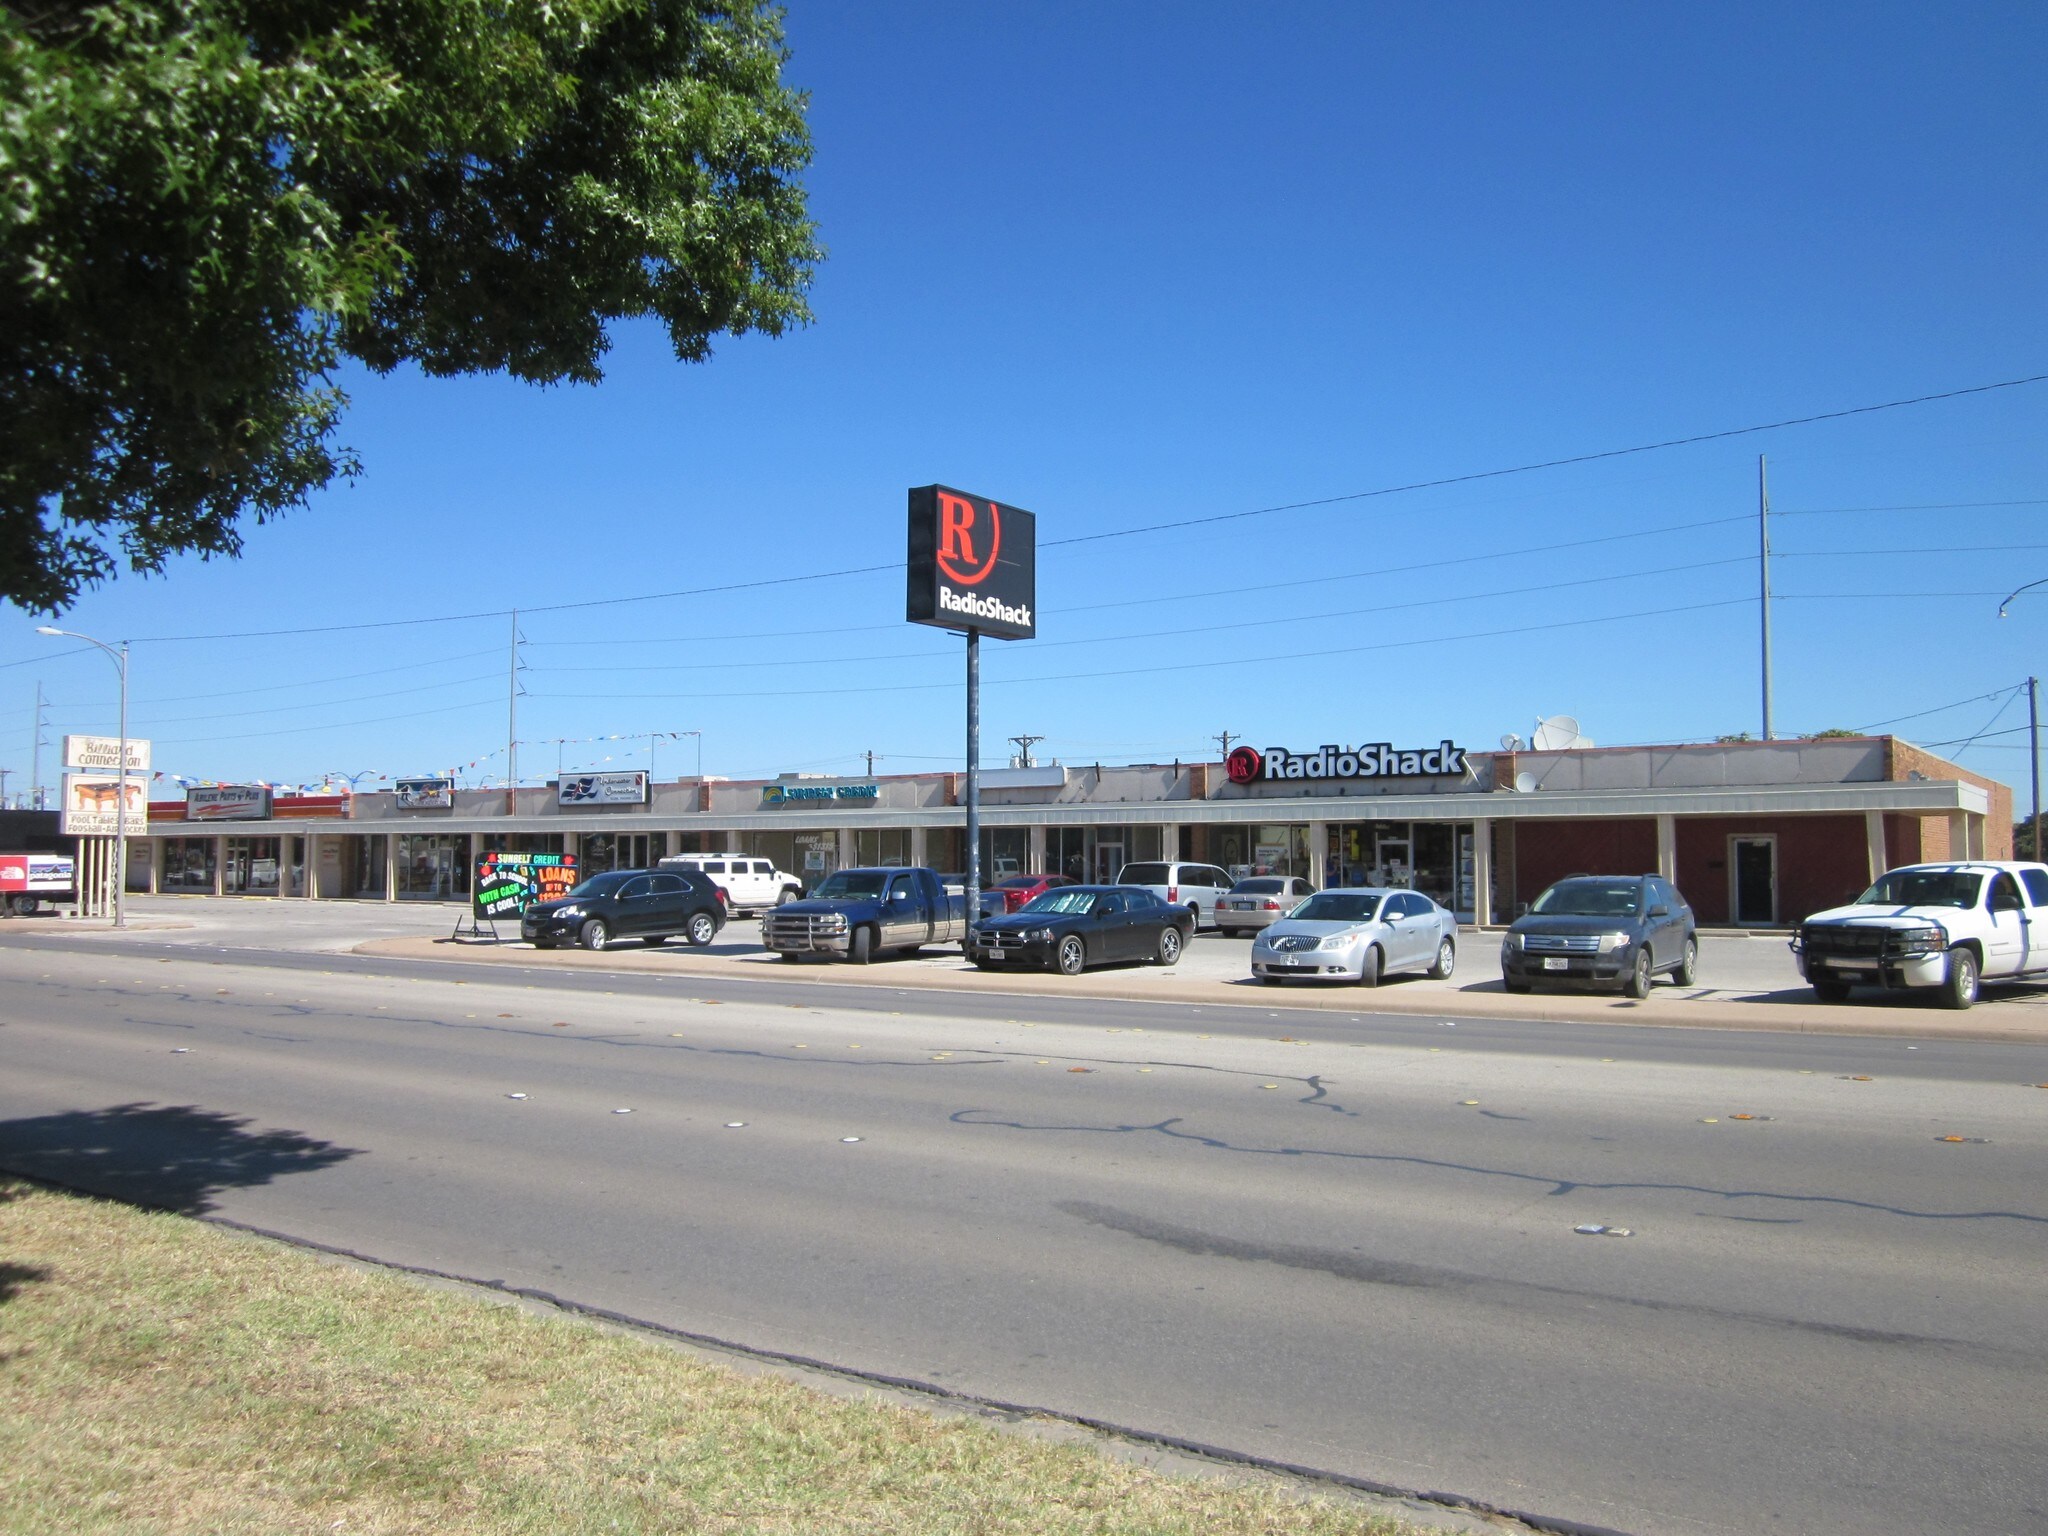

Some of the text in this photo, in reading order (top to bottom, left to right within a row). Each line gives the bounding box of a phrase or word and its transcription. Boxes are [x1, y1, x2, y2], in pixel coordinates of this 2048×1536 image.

[940, 586, 1031, 626] RadioShack
[86, 742, 133, 755] Billiad
[79, 754, 141, 767] Connecon
[1265, 741, 1462, 779] RadioShack
[836, 786, 877, 798] CREDIT
[497, 853, 560, 865] SUNBELT CREDIT
[30, 871, 72, 881] patagonia
[481, 871, 528, 886] BACK TO SCHOOL
[539, 867, 576, 884] LOANS
[479, 883, 521, 903] WITH CASH
[545, 883, 562, 891] UP TO
[486, 895, 519, 915] IS COOL!
